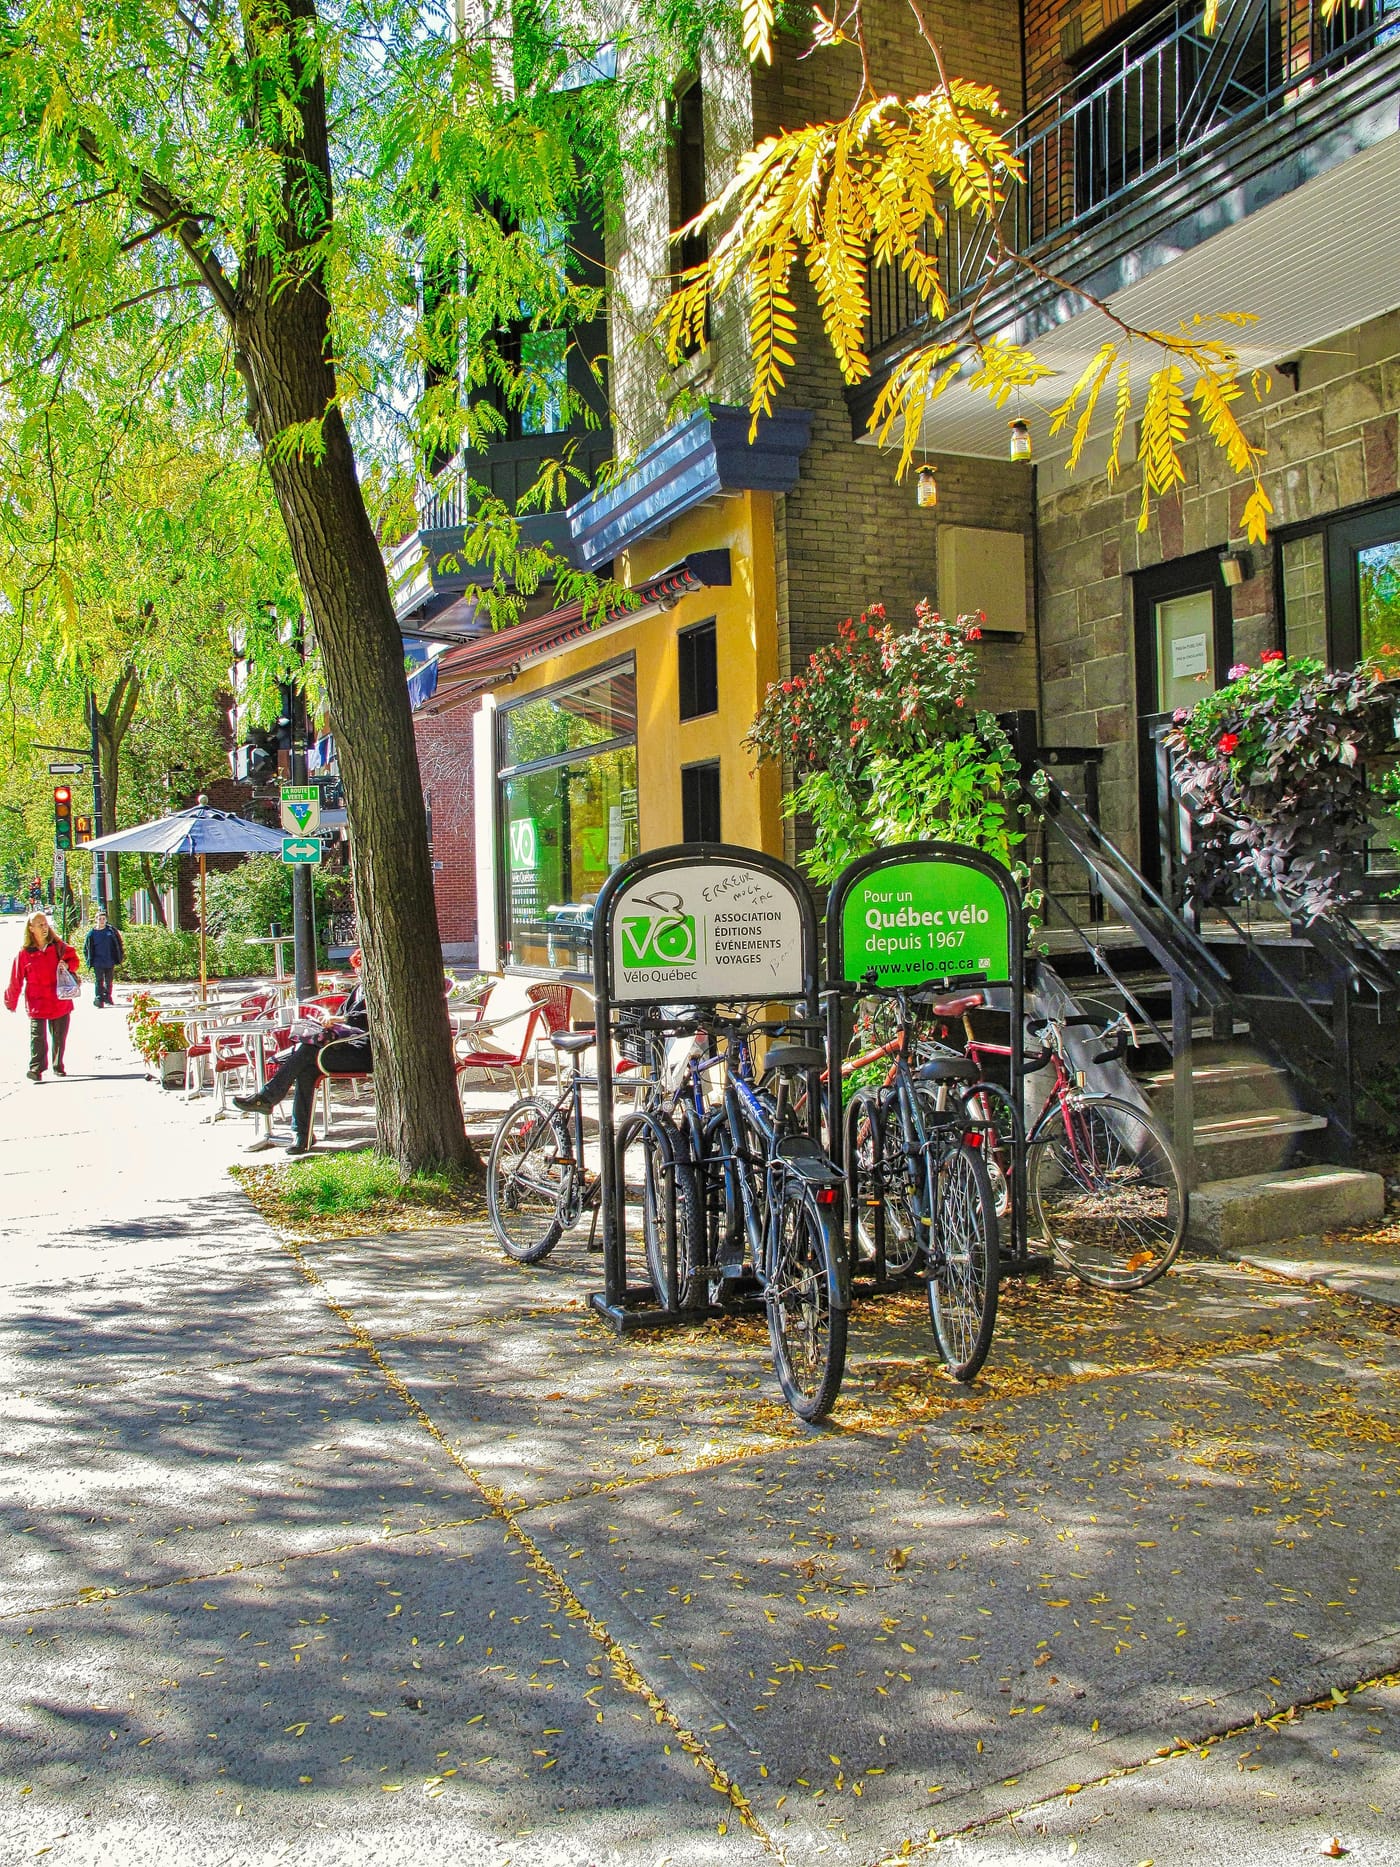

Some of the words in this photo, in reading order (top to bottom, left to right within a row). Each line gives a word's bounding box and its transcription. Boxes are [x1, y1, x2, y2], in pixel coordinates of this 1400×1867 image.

[510, 818, 535, 867] VQ
[702, 872, 754, 902] ERREUR
[864, 890, 893, 903] Pour
[896, 891, 913, 902] un
[714, 912, 782, 923] ASSOCIATION
[865, 907, 944, 931] Québec
[947, 904, 989, 925] vélo
[714, 926, 762, 937] ÉDITIONS
[715, 939, 782, 951] ÉVÉNEMENTS
[865, 933, 922, 955] depuis
[927, 931, 965, 948] 1967
[715, 954, 762, 965] VOYAGES
[867, 958, 974, 974] www.velo.qc.ca
[623, 970, 649, 983] Vélo
[651, 969, 697, 983] Québec
